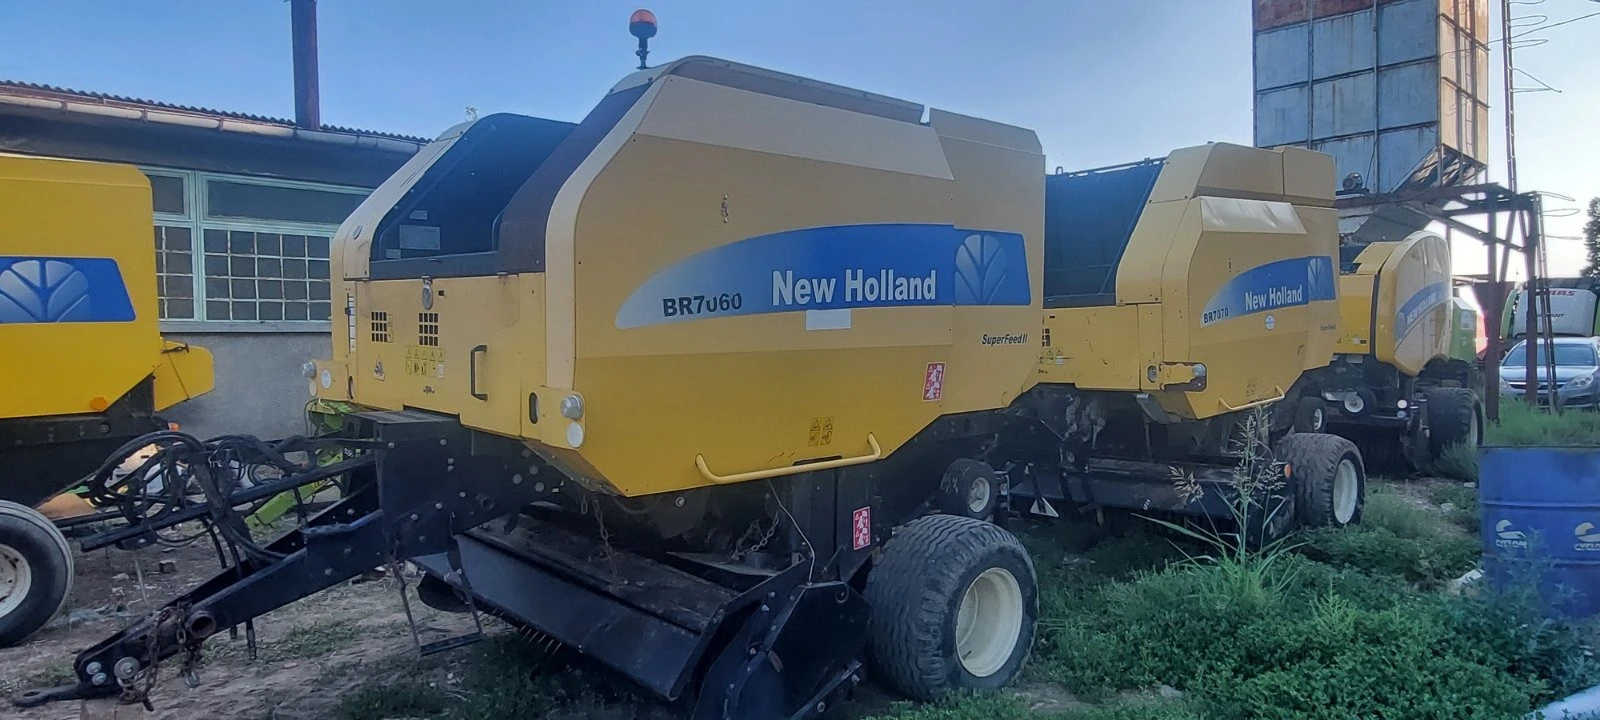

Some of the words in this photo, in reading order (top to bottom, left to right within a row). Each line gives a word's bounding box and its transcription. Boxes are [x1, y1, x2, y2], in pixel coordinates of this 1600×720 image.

[772, 270, 836, 306] New
[845, 268, 936, 302] Holland
[1245, 291, 1267, 311] New
[1269, 284, 1303, 307] Holland
[662, 292, 742, 317] BR7060
[1203, 307, 1229, 324] BR7070
